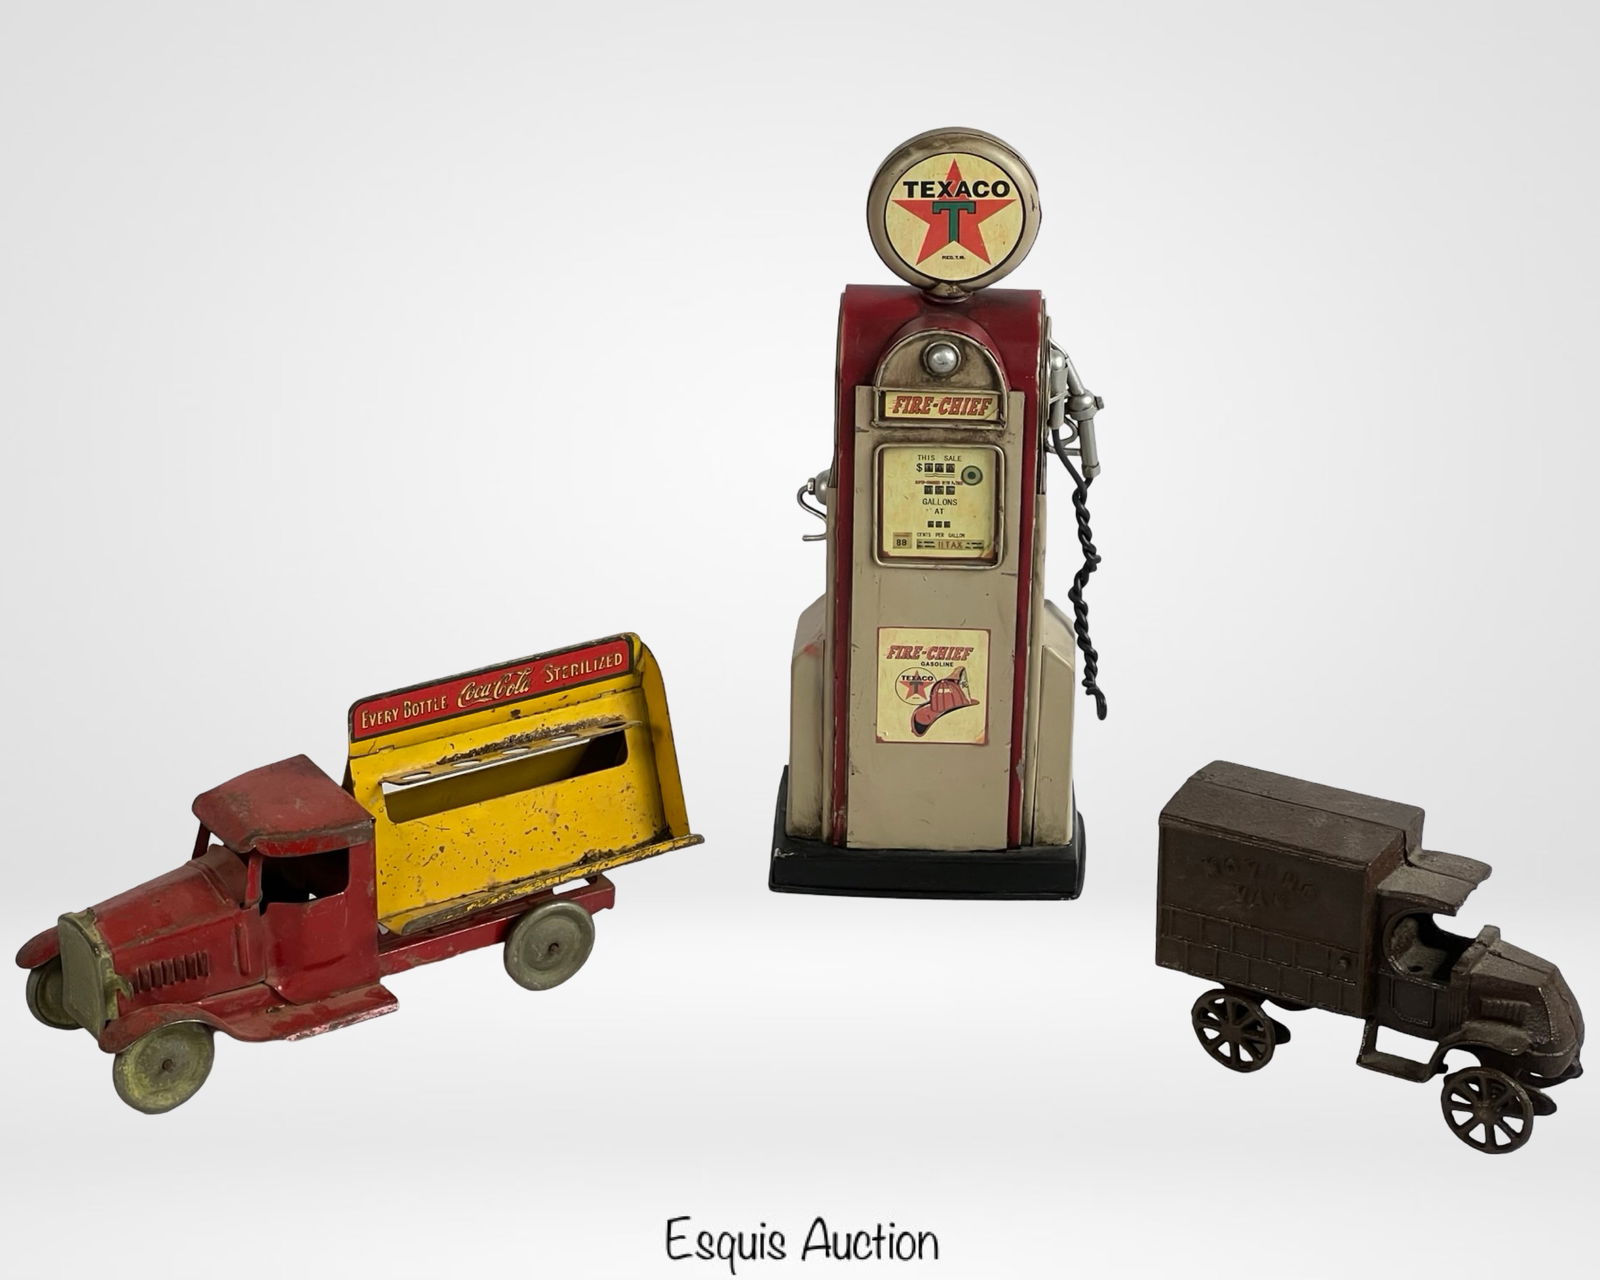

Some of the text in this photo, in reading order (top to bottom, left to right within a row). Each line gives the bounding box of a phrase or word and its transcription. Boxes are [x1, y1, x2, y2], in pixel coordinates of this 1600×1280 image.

[902, 180, 1011, 198] TEXACO
[932, 201, 977, 244] T
[891, 395, 993, 416] FIRE-CHIEF
[922, 498, 958, 506] GALLONS
[886, 645, 975, 661] FIRE-CHIEF
[361, 709, 399, 730] EVERY
[402, 695, 448, 720] BOTTLE
[544, 652, 624, 684] STERILIZED
